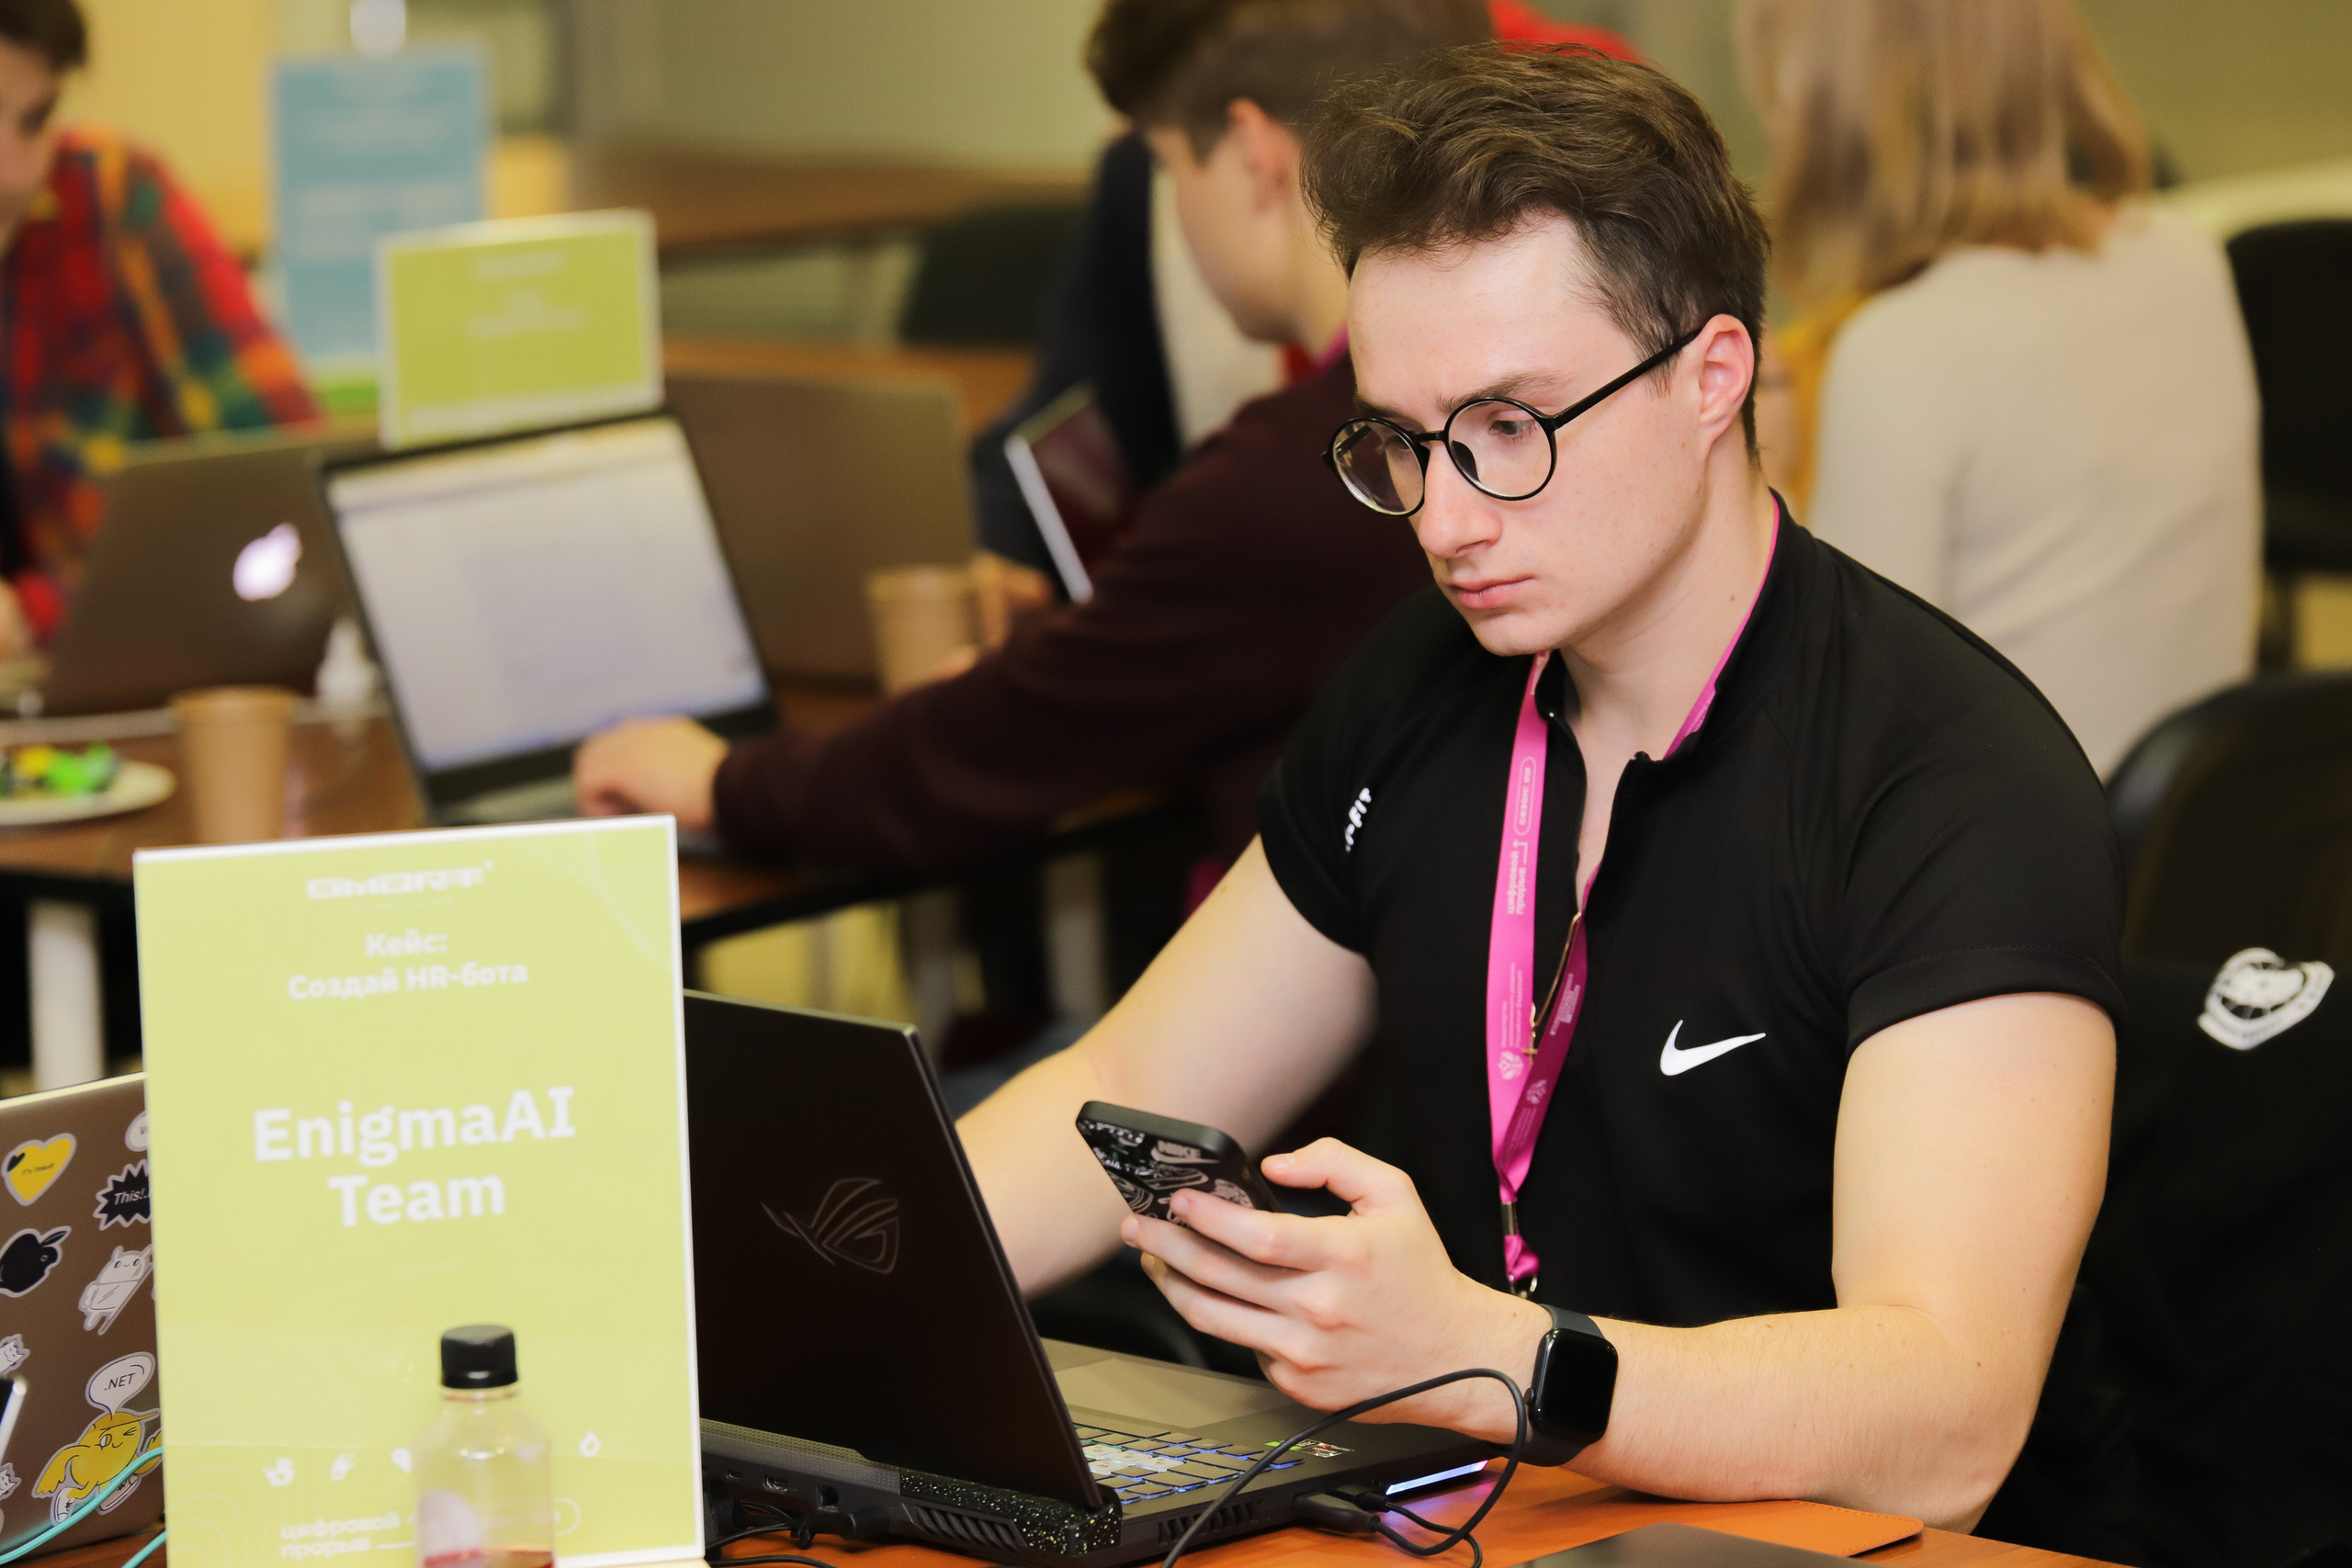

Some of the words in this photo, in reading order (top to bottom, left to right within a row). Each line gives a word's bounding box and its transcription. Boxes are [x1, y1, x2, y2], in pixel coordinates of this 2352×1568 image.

[365, 928, 448, 958] Кейс:
[287, 966, 400, 1001] Создай
[405, 961, 529, 990] HR-бота
[252, 1086, 577, 1168] EnigmaAI
[326, 1173, 506, 1228] Team
[104, 1372, 136, 1391] .NET
